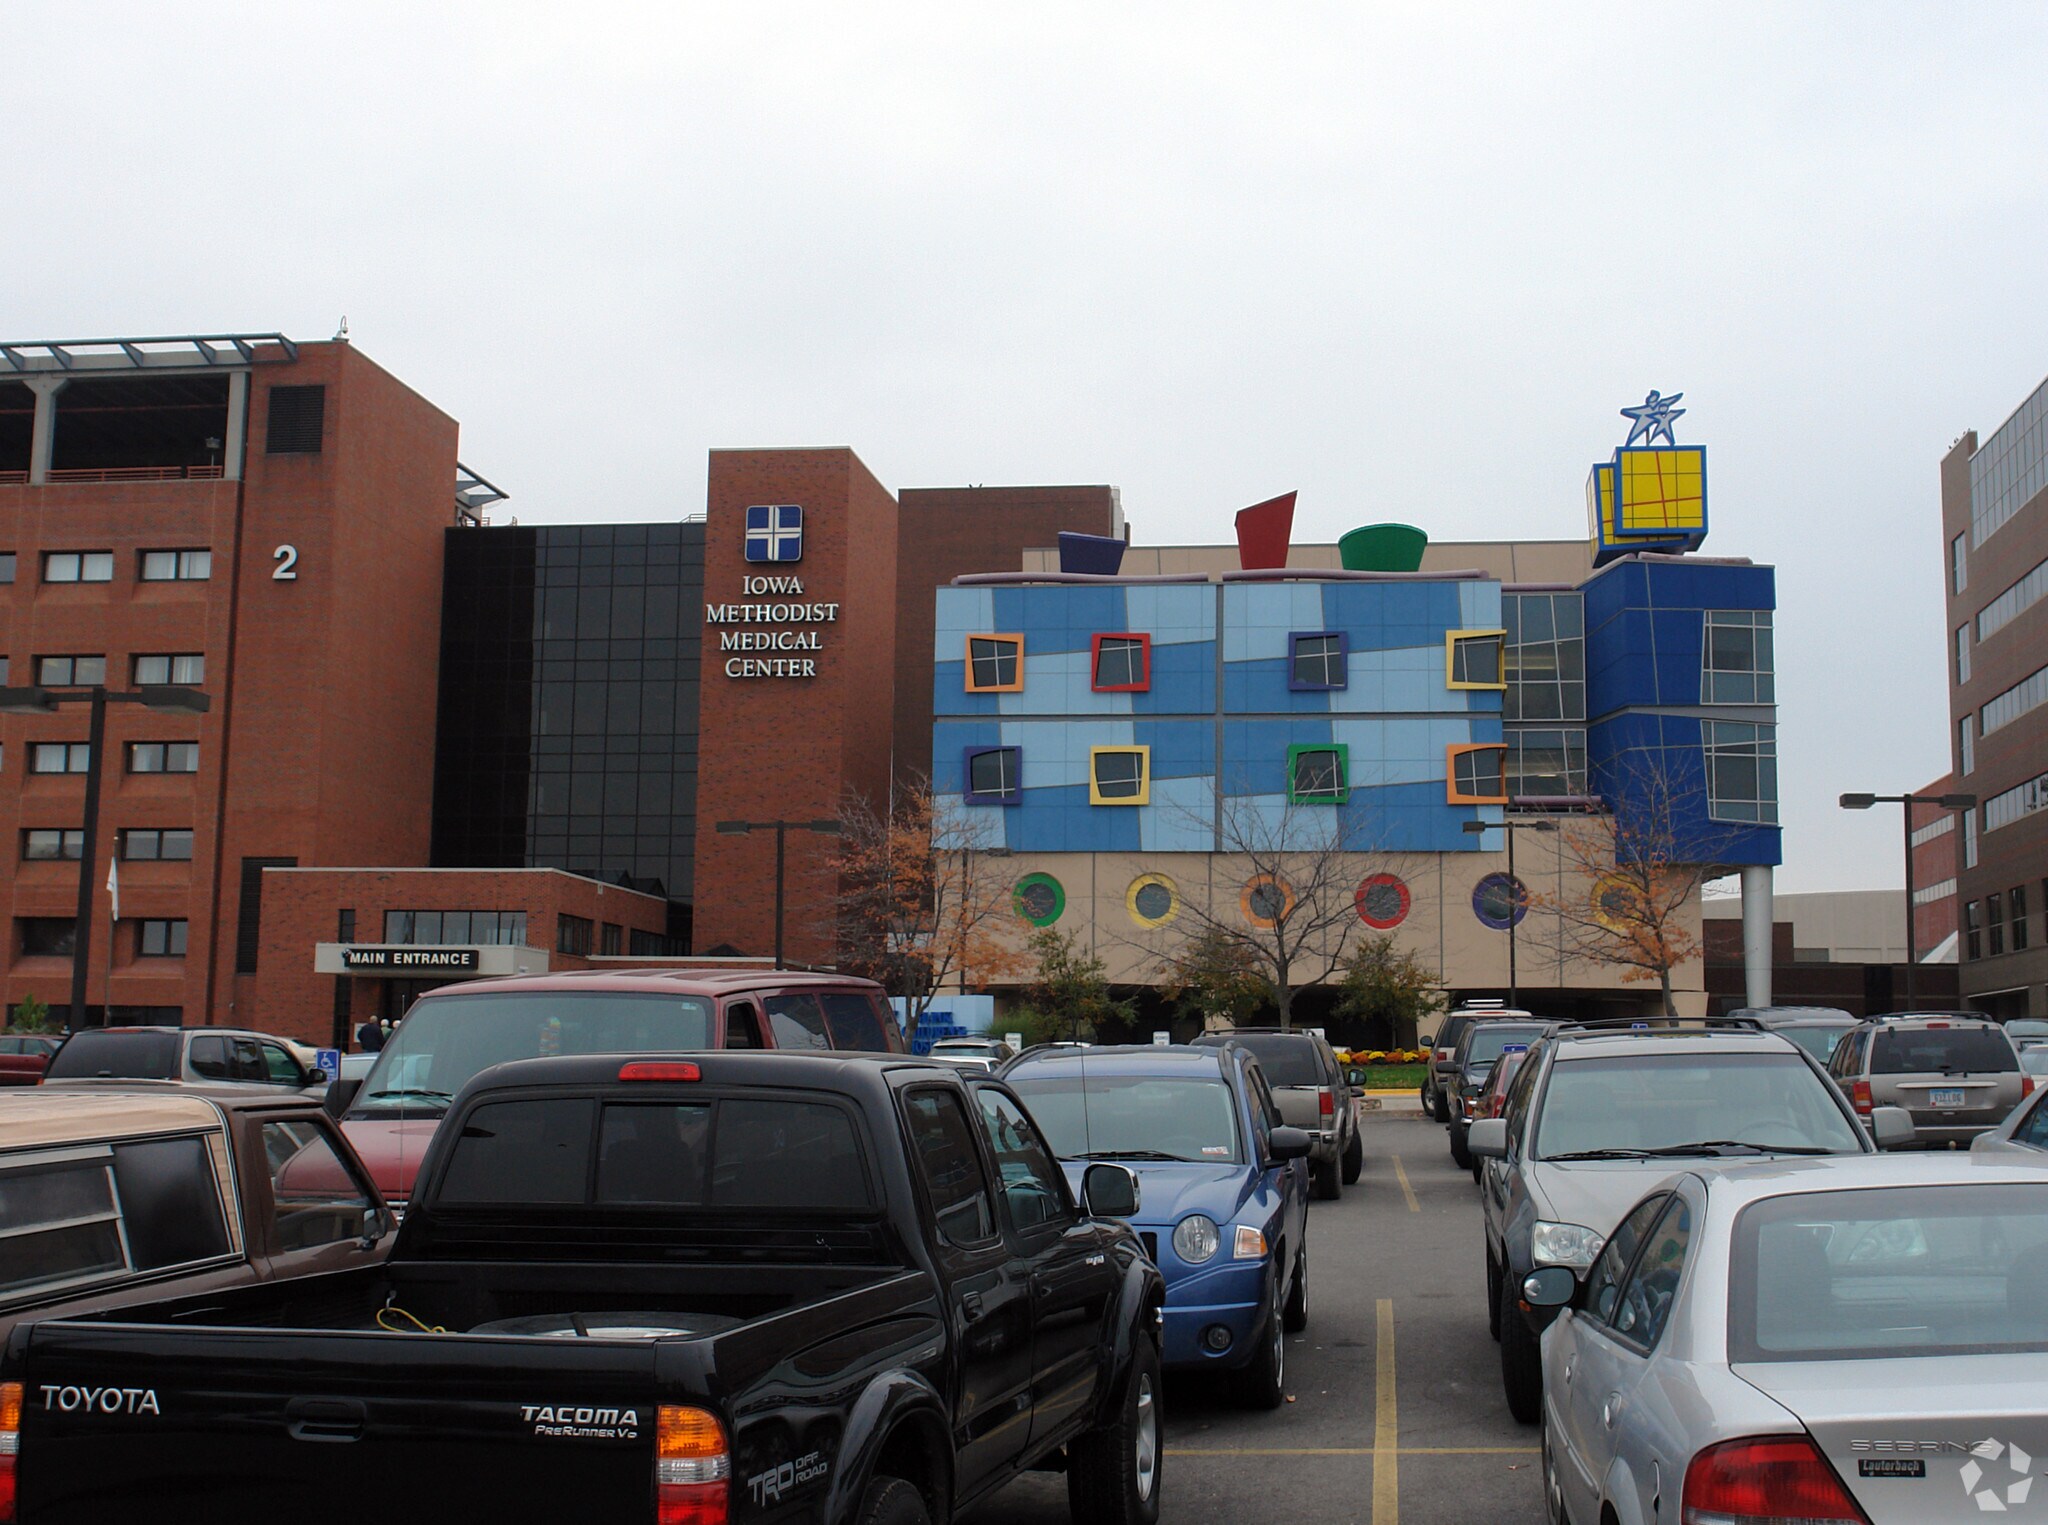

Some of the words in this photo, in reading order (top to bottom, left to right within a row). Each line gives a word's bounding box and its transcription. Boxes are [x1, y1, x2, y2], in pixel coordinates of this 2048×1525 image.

[272, 544, 297, 579] 2
[742, 575, 803, 594] IOWA
[706, 603, 839, 622] METHODIST
[720, 631, 823, 650] MEDICAL
[725, 657, 816, 677] CENTER
[350, 952, 385, 964] MAIN
[393, 953, 470, 964] ENTRANCE
[40, 1385, 160, 1415] TOYOTA
[521, 1405, 638, 1426] TACOMA
[1851, 1439, 1993, 1452] SEBRING
[795, 1451, 819, 1470] OFF
[1862, 1459, 1921, 1472] Lauterbach
[795, 1462, 828, 1484] ROAD
[747, 1461, 794, 1508] TRD
